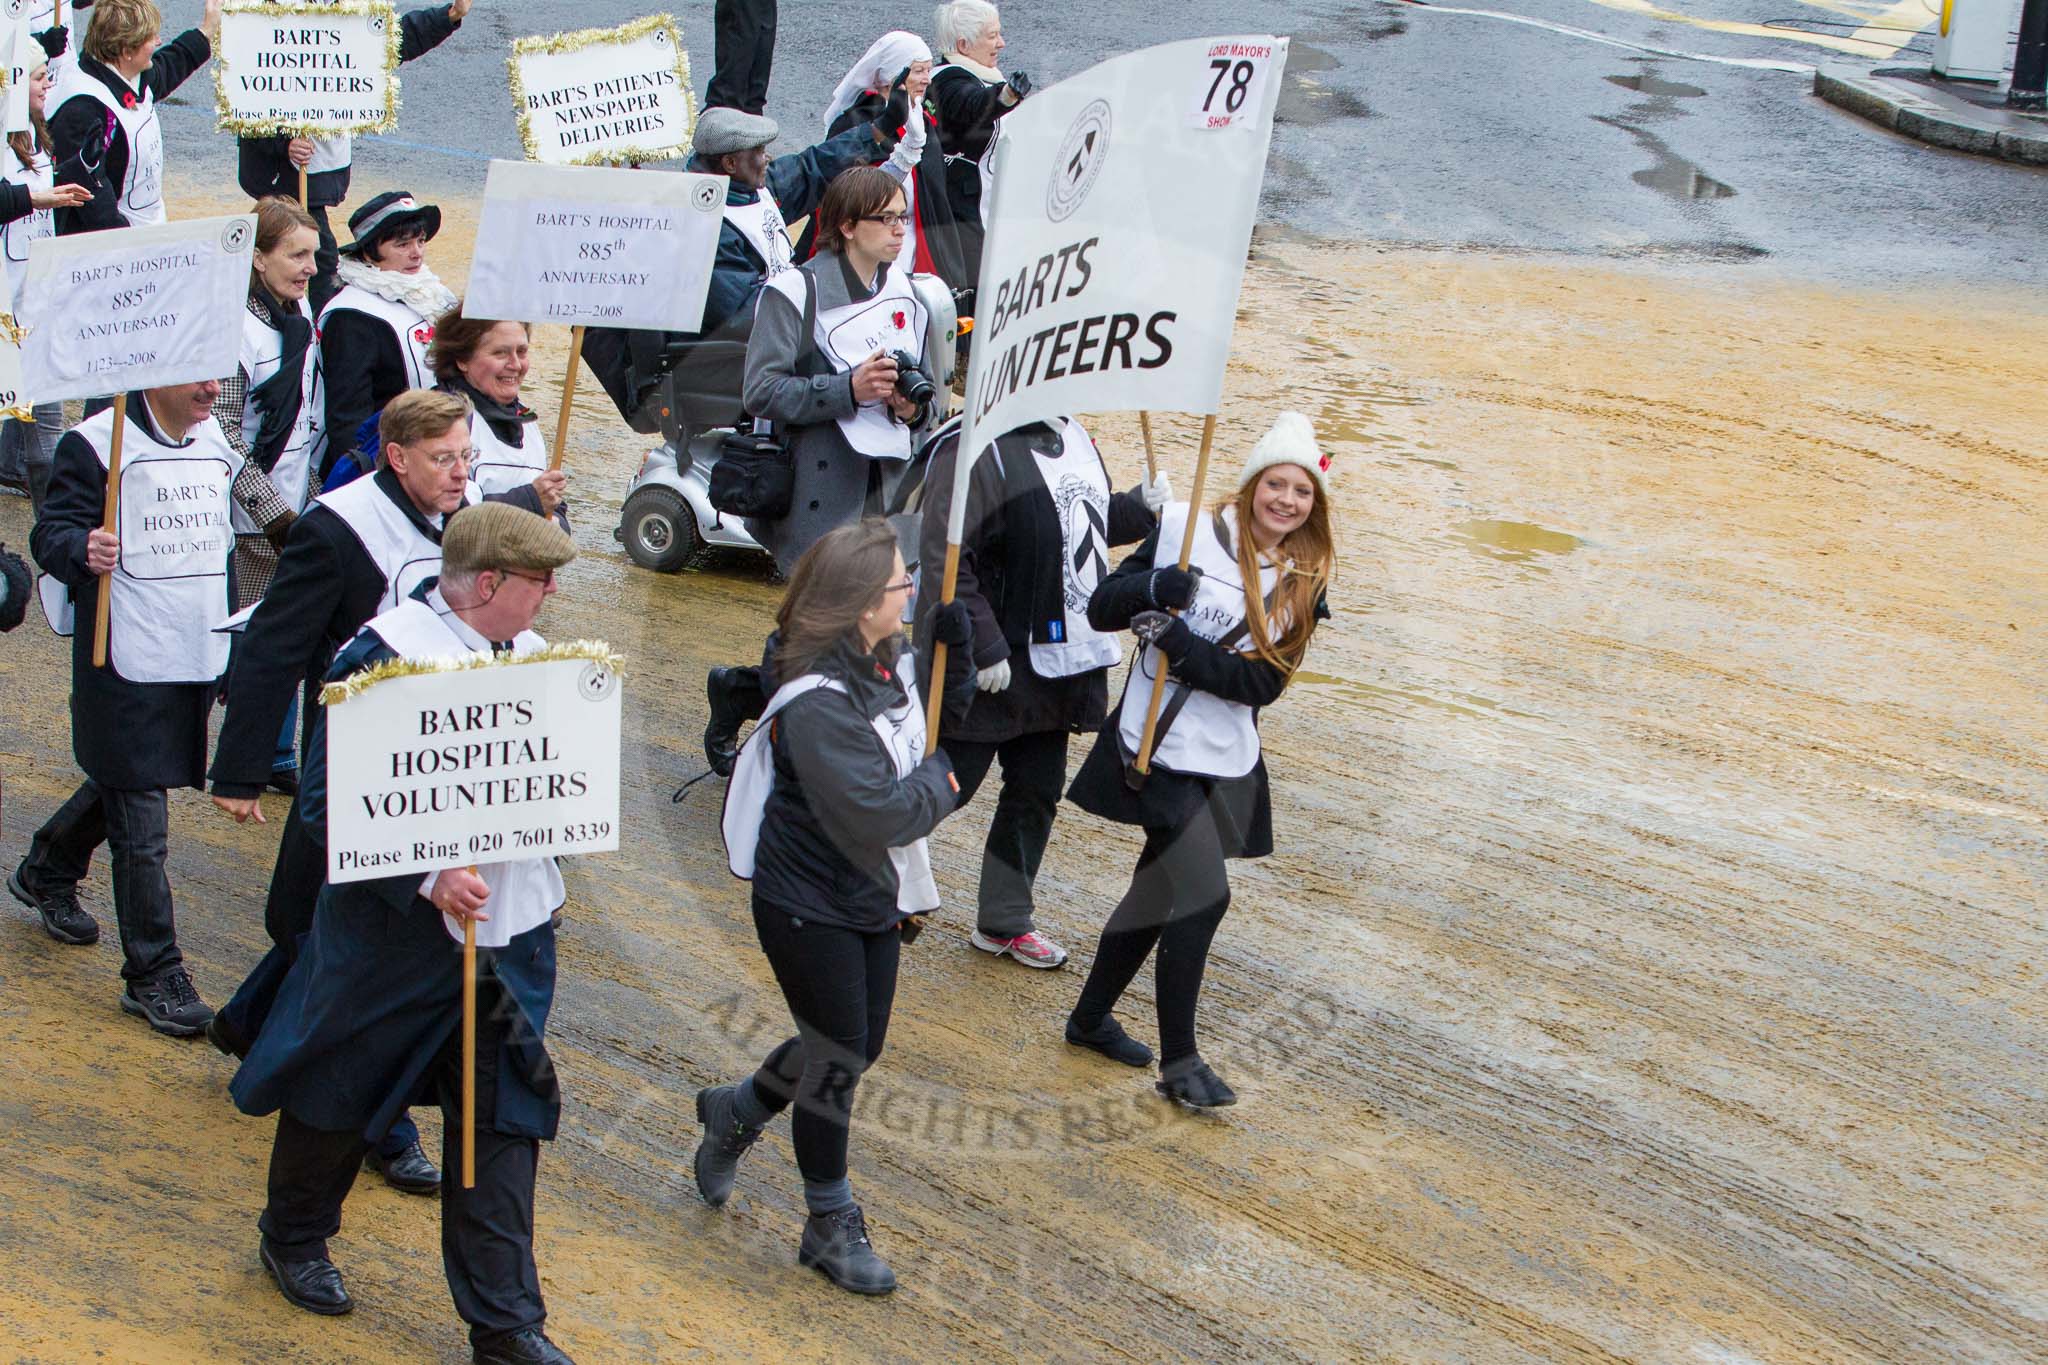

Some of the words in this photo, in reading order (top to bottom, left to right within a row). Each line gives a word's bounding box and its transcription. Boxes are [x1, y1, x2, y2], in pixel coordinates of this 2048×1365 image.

[274, 29, 341, 45] BART'S
[1208, 45, 1229, 57] LORD
[1230, 44, 1271, 58] MAYOR'S
[257, 52, 357, 69] HOSPITAL
[240, 75, 374, 93] VOLUNTEERS
[527, 85, 588, 110] BART'S
[594, 69, 674, 98] PATIENTS
[1202, 59, 1254, 113] 78
[231, 108, 263, 120] lease
[269, 108, 297, 120] Ring
[302, 109, 323, 120] 020
[329, 109, 353, 120] 7601
[359, 109, 387, 120] 8339
[554, 93, 660, 127] NEWSPAPER
[559, 113, 665, 148] DELIVERIES
[536, 213, 591, 227] BART'S
[599, 215, 673, 231] HOSPITAL
[578, 238, 626, 261] 885th
[72, 264, 123, 284] BART'S
[130, 253, 200, 275] HOSPITAL
[538, 271, 650, 286] ANNIVERSARY
[112, 281, 157, 311] 885th
[989, 236, 1099, 343] BARTS
[75, 312, 181, 341] ANNIVERSARY
[157, 484, 218, 502] BART'S
[144, 511, 225, 531] HOSPITAL
[419, 699, 533, 736] BART'S
[391, 736, 559, 778] HOSPITAL
[361, 771, 588, 820] VOLUNTEERS
[338, 850, 402, 870] Please
[413, 841, 460, 861] Ring
[469, 832, 503, 853] 020
[512, 827, 553, 848] 7601
[564, 821, 611, 843] 8339
